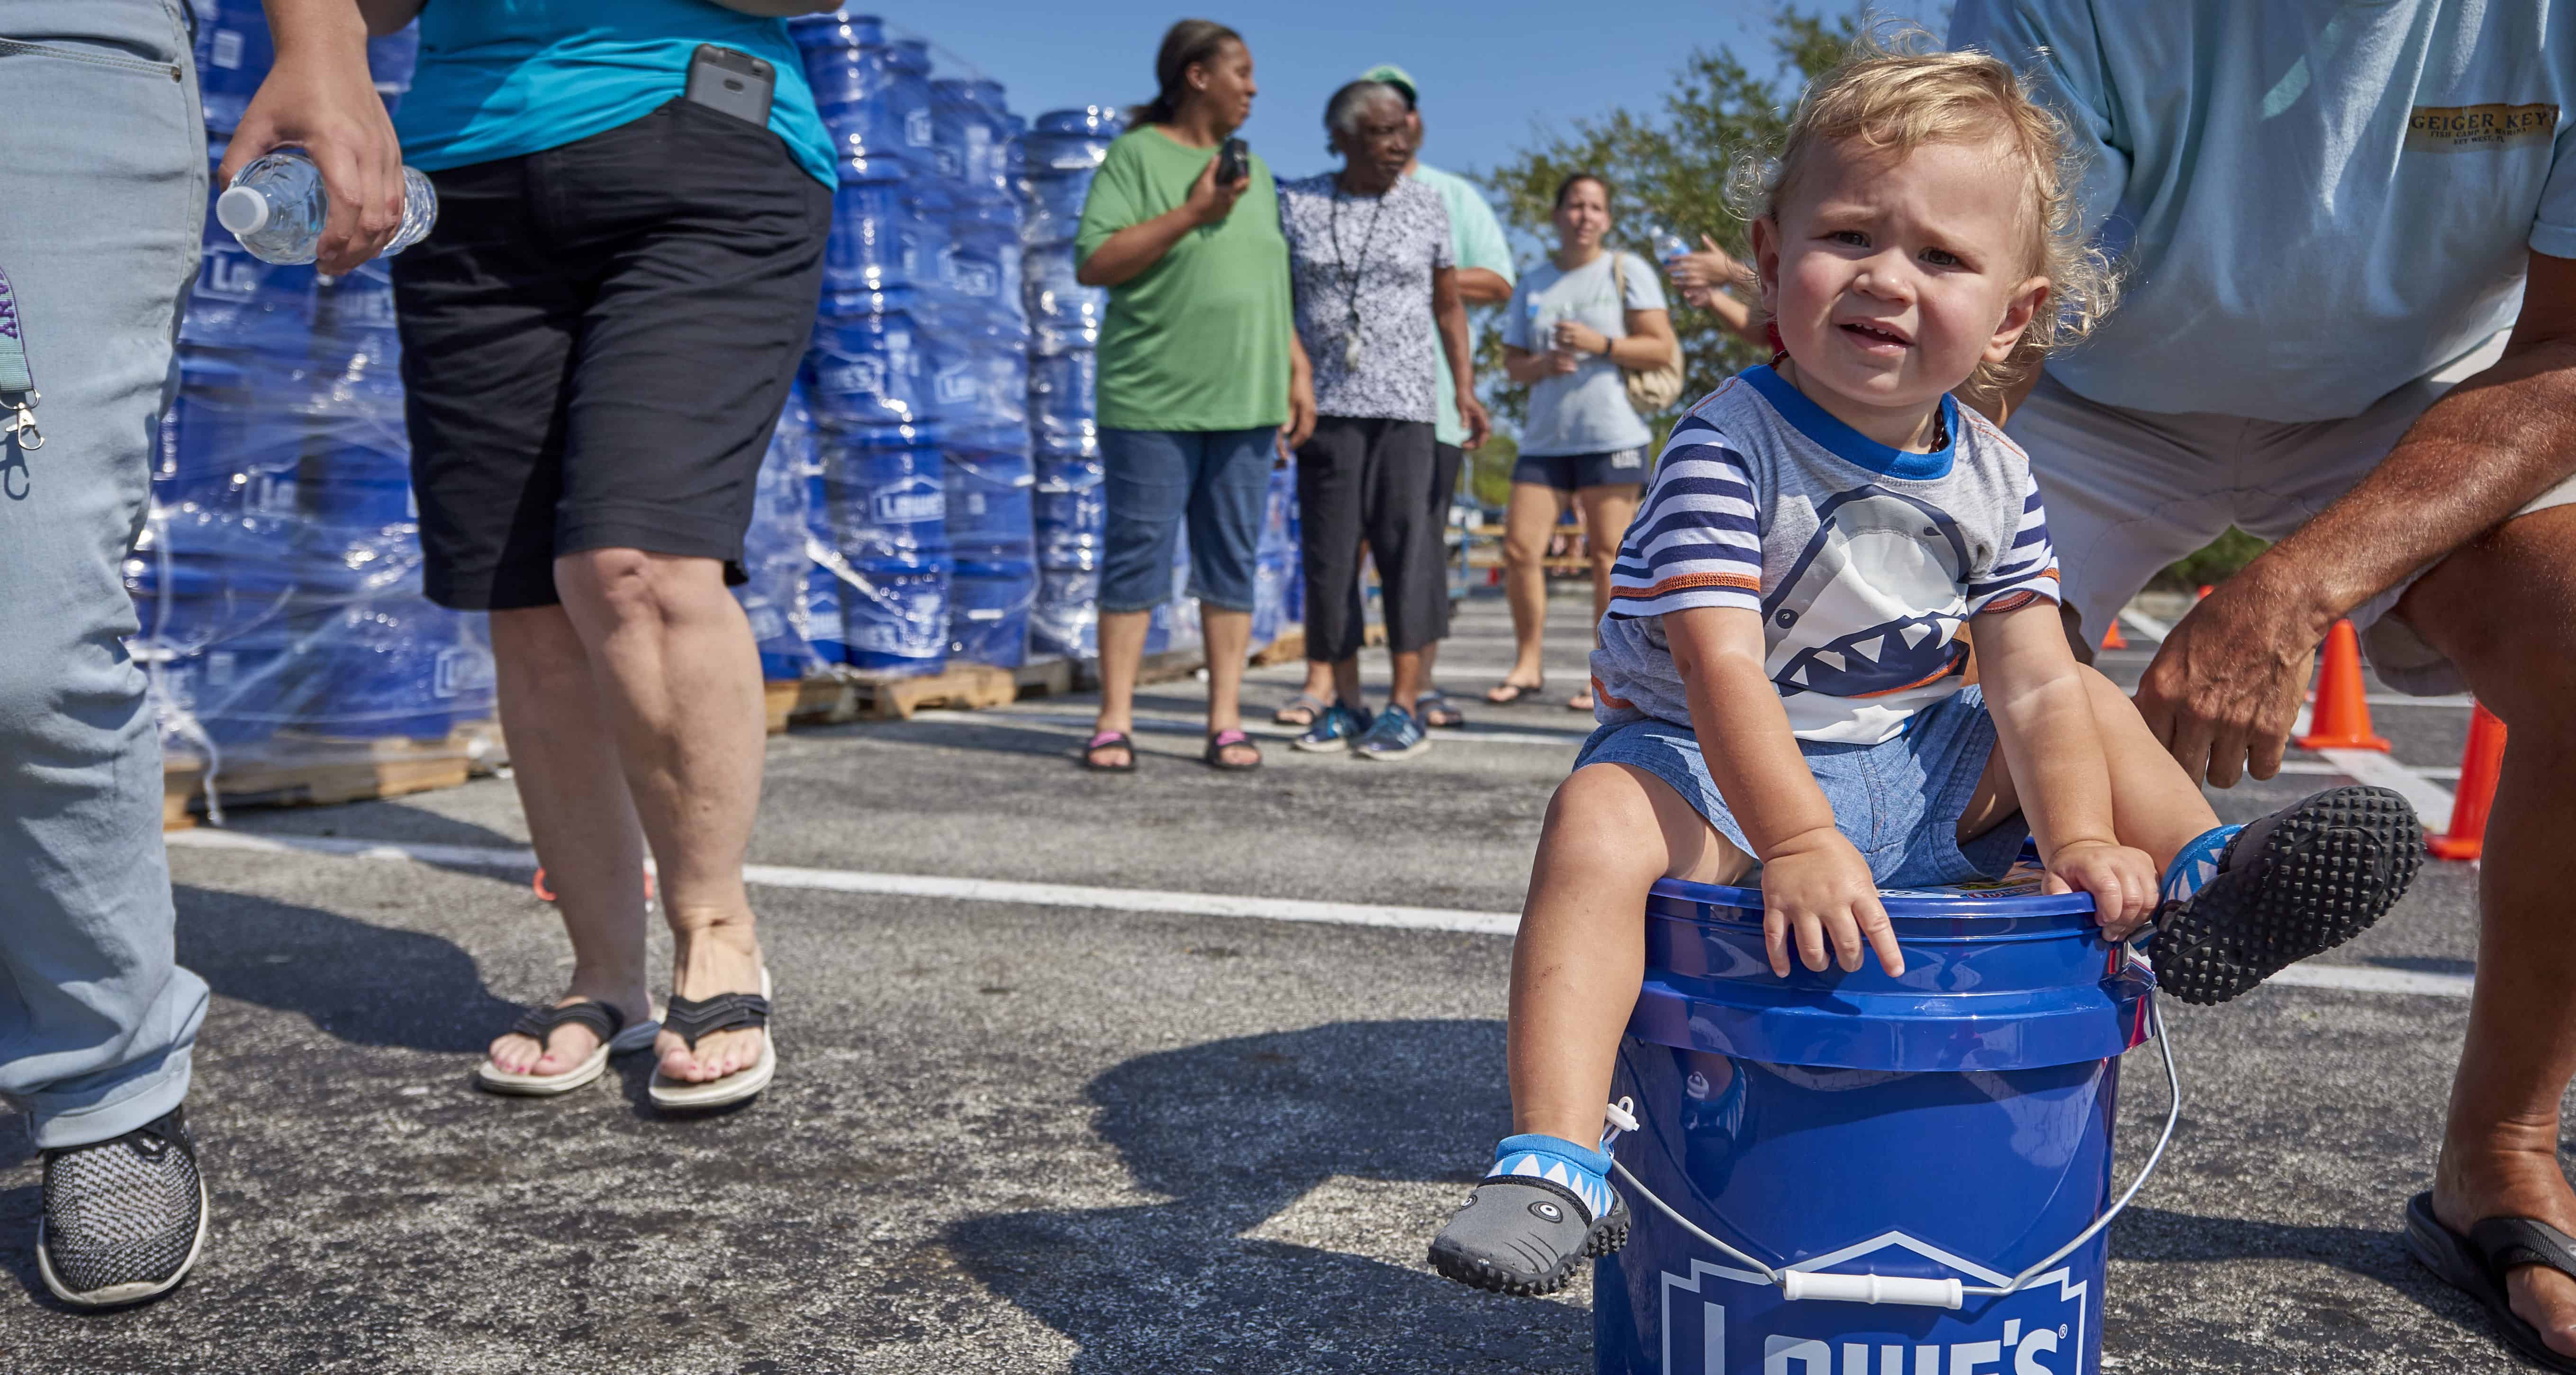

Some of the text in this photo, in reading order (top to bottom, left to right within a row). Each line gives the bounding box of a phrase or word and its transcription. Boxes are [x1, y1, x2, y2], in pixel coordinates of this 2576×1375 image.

[2411, 112, 2548, 131] GEIGER KEY
[2456, 129, 2479, 137] CAMP
